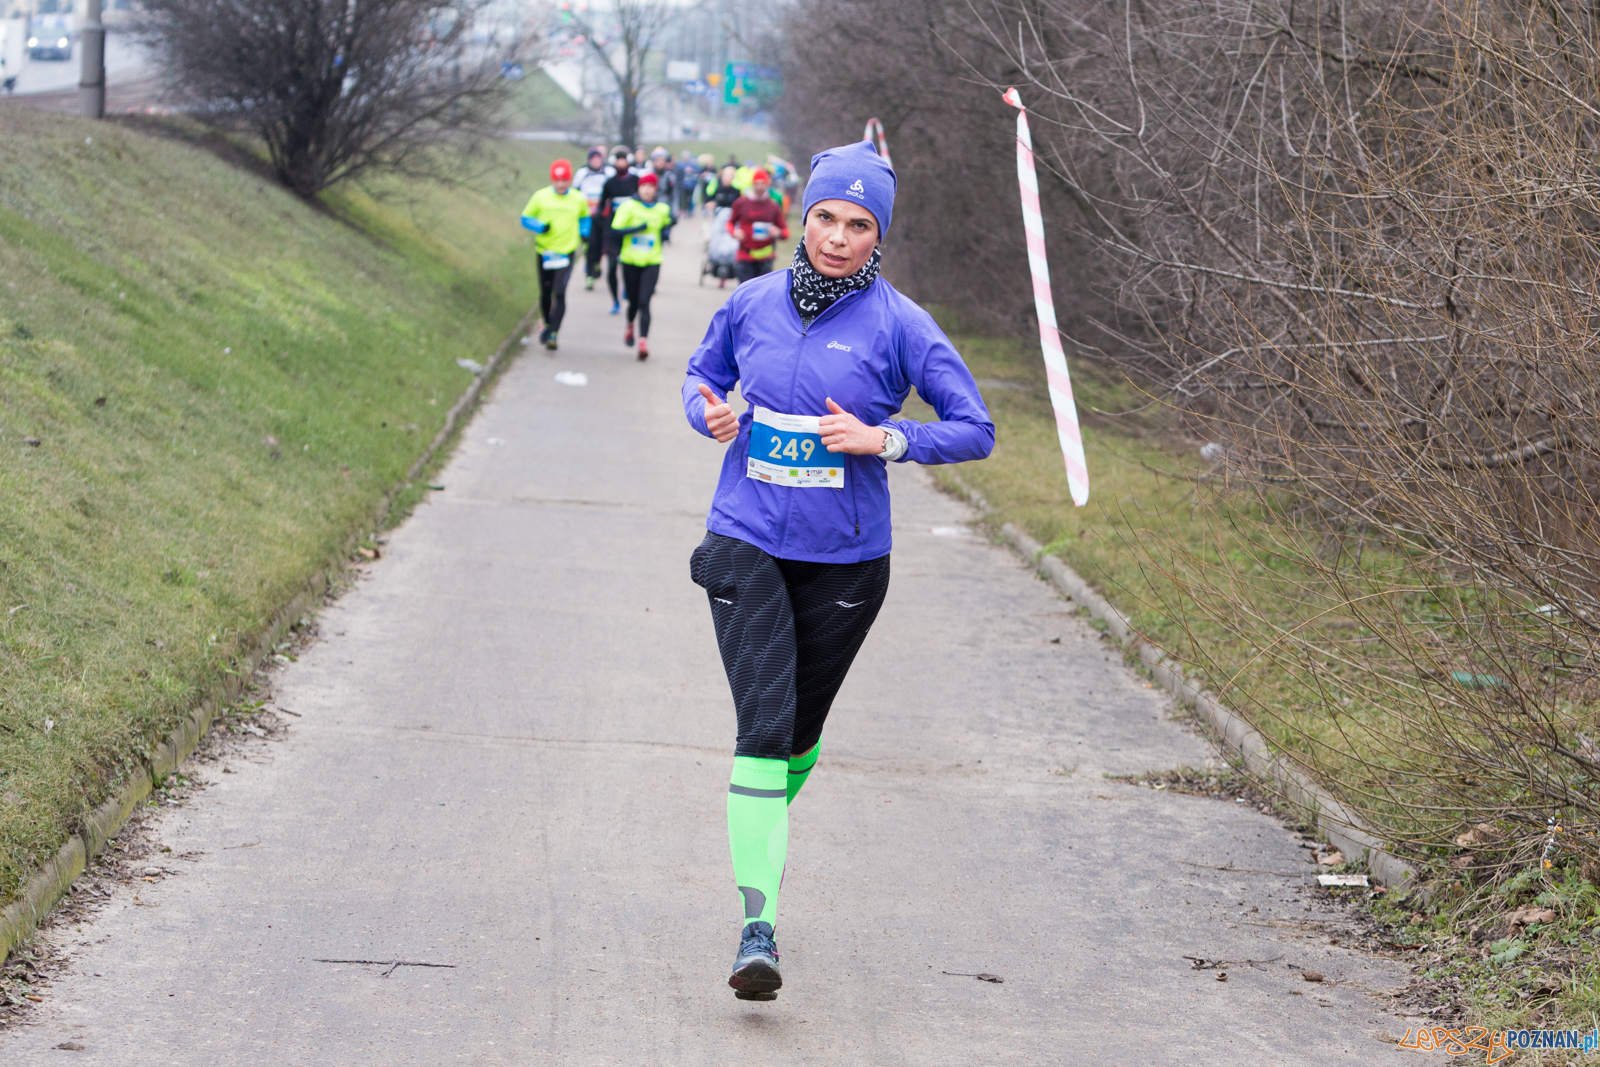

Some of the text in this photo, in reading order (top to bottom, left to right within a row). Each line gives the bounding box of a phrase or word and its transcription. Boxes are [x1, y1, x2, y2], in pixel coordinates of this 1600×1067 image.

[801, 267, 812, 275] Liv
[809, 274, 822, 282] Liv
[768, 435, 816, 461] 249
